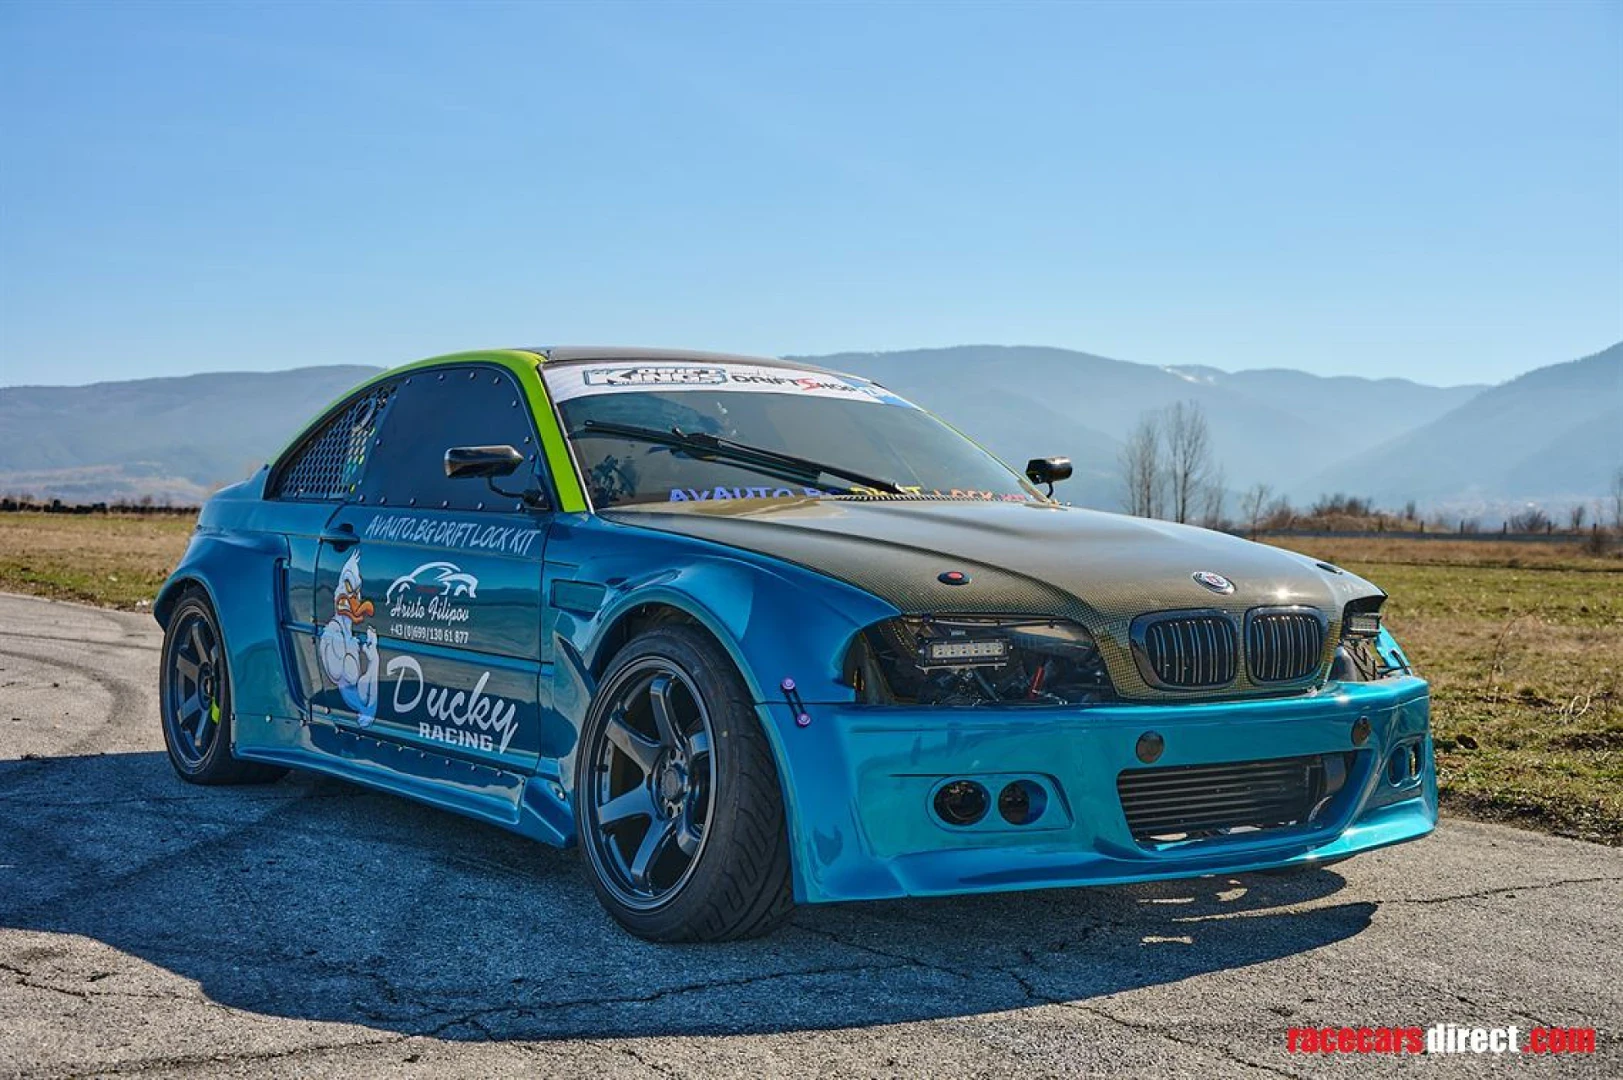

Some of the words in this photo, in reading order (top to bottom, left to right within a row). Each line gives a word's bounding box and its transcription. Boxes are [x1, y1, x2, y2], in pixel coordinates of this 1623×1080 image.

[365, 514, 435, 544] AVAUTO.BG
[433, 522, 478, 548] DRIFT
[469, 525, 510, 551] LOCK
[509, 529, 541, 556] KIT
[428, 596, 469, 626] Filipov
[390, 623, 403, 636] +43
[443, 629, 453, 642] 61
[454, 631, 469, 644] 877
[387, 655, 518, 754] Ducky
[418, 721, 494, 752] RACING
